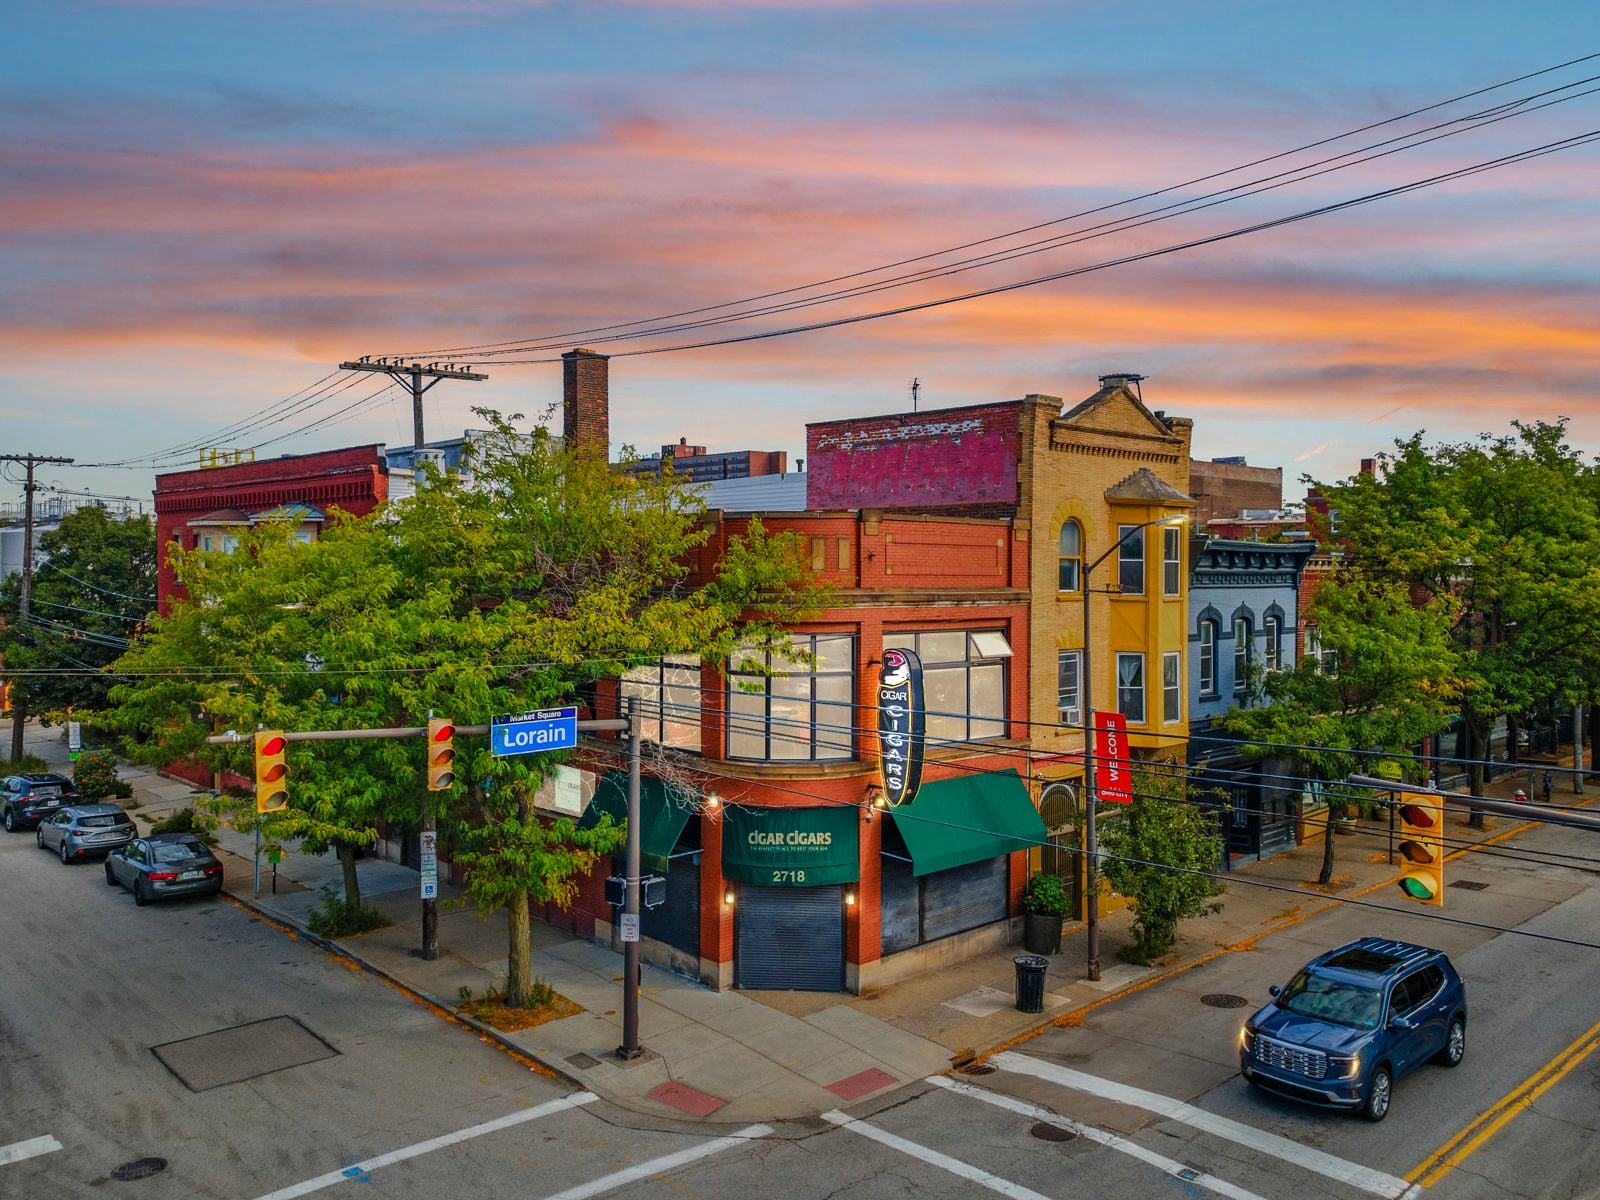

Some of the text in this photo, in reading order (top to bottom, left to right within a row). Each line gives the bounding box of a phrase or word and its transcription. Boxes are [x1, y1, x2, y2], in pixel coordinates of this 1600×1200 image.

[881, 690, 907, 701] CIGAR
[510, 711, 562, 722] Market Square
[504, 723, 566, 748] Lorain
[886, 705, 904, 790] CIGARS
[773, 871, 805, 882] 2718
